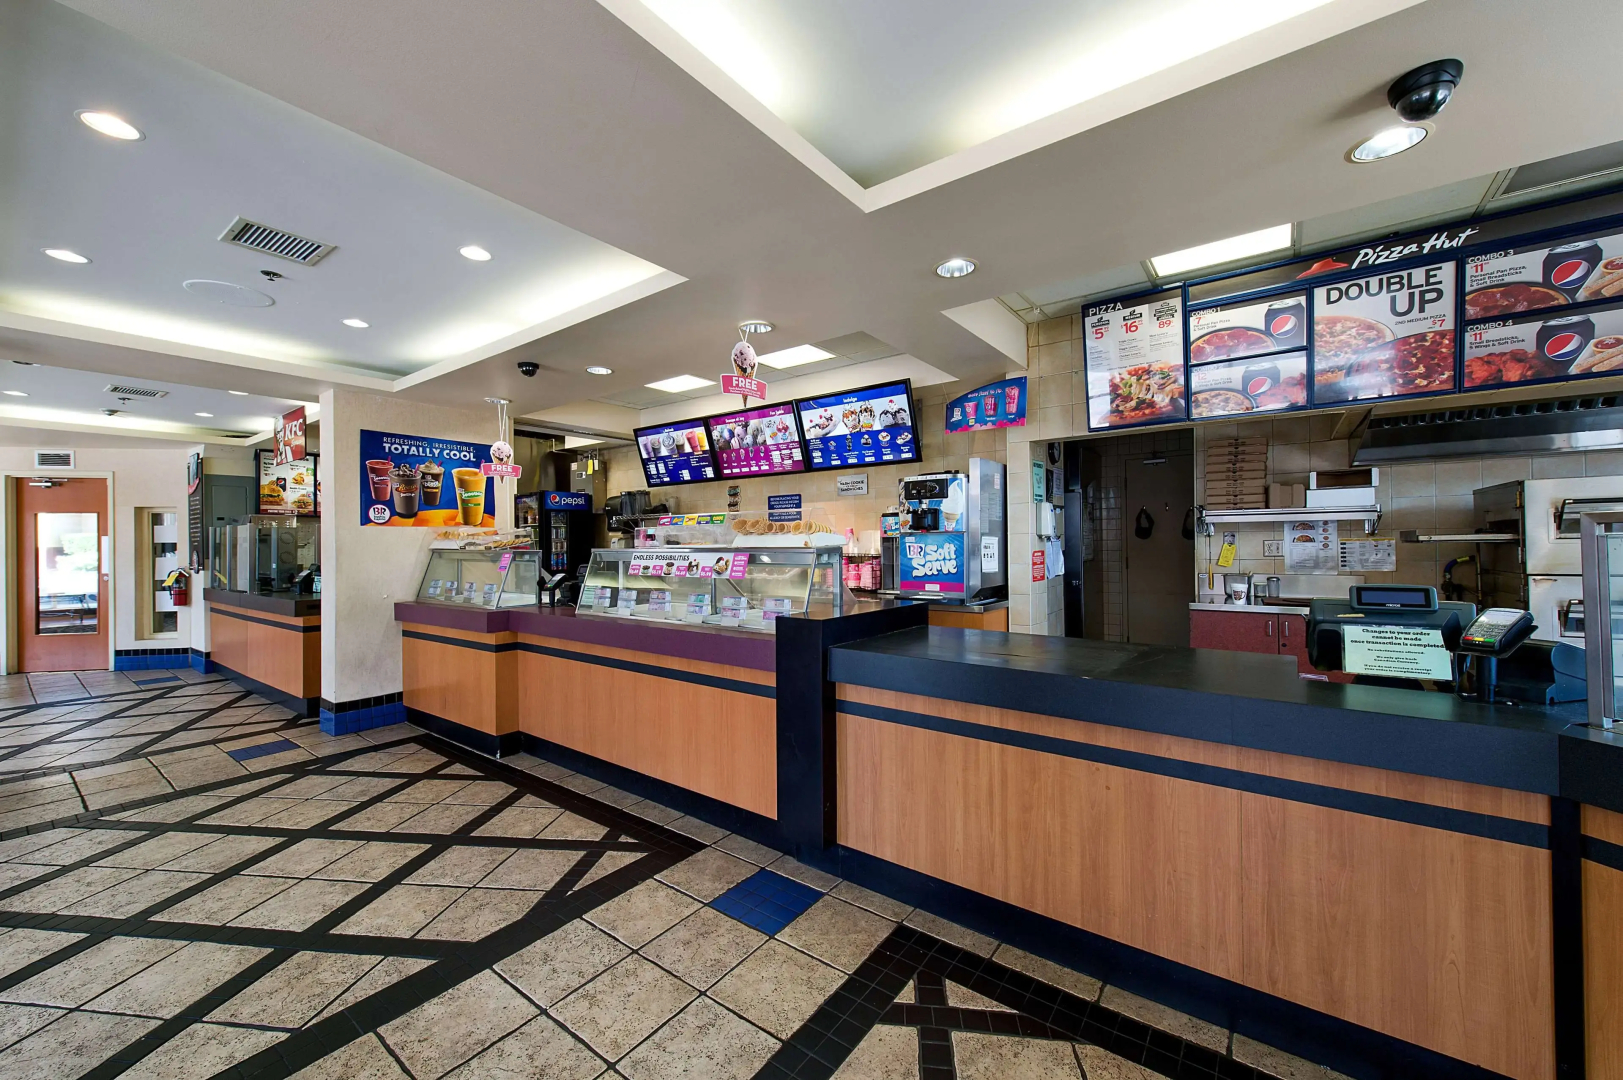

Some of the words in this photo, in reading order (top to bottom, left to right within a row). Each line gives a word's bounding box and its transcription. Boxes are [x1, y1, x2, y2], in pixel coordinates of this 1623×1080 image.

[1352, 246, 1419, 269] Pizza
[1423, 228, 1479, 254] Hut
[1468, 252, 1504, 264] COMBO
[1470, 270, 1494, 279] Personal
[1488, 270, 1522, 280] Breadsticks
[1326, 266, 1442, 305] DOUBLE
[1090, 302, 1123, 316] PIZZA
[1390, 288, 1444, 317] UP
[1192, 308, 1216, 317] COMBO
[1432, 318, 1446, 328] $7
[1468, 321, 1504, 332] COMBO
[732, 376, 757, 390] FREE
[285, 418, 303, 440] KFC
[383, 443, 440, 458] TOTALLY
[443, 450, 476, 461] COOL
[562, 496, 585, 506] pepsi
[908, 544, 924, 557] BR
[926, 542, 956, 561] Soft
[912, 558, 958, 577] Serve
